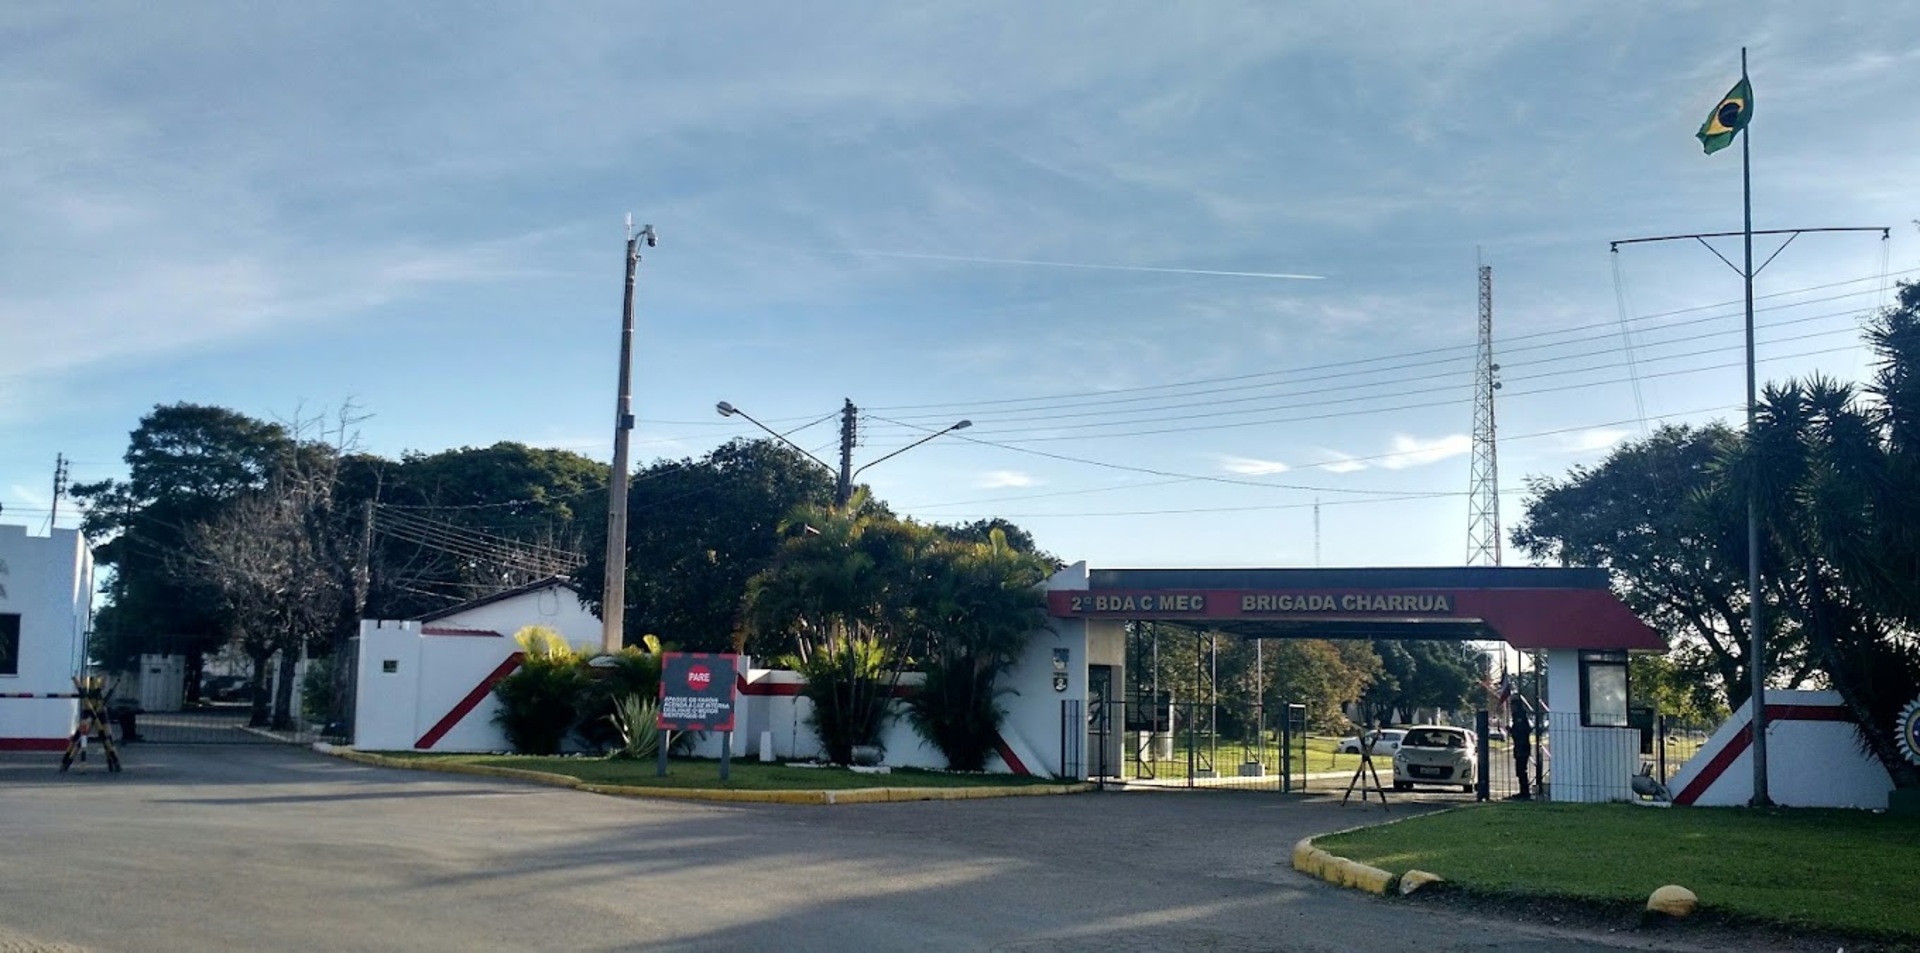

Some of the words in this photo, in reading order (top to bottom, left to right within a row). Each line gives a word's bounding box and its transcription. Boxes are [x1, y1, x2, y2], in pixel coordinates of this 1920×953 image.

[1096, 596, 1136, 610] BDA
[1141, 596, 1153, 610] C
[1160, 596, 1203, 610] MEC
[1241, 595, 1337, 611] BRIGADA
[1342, 595, 1449, 611] CHARRUA
[688, 672, 710, 682] PARE
